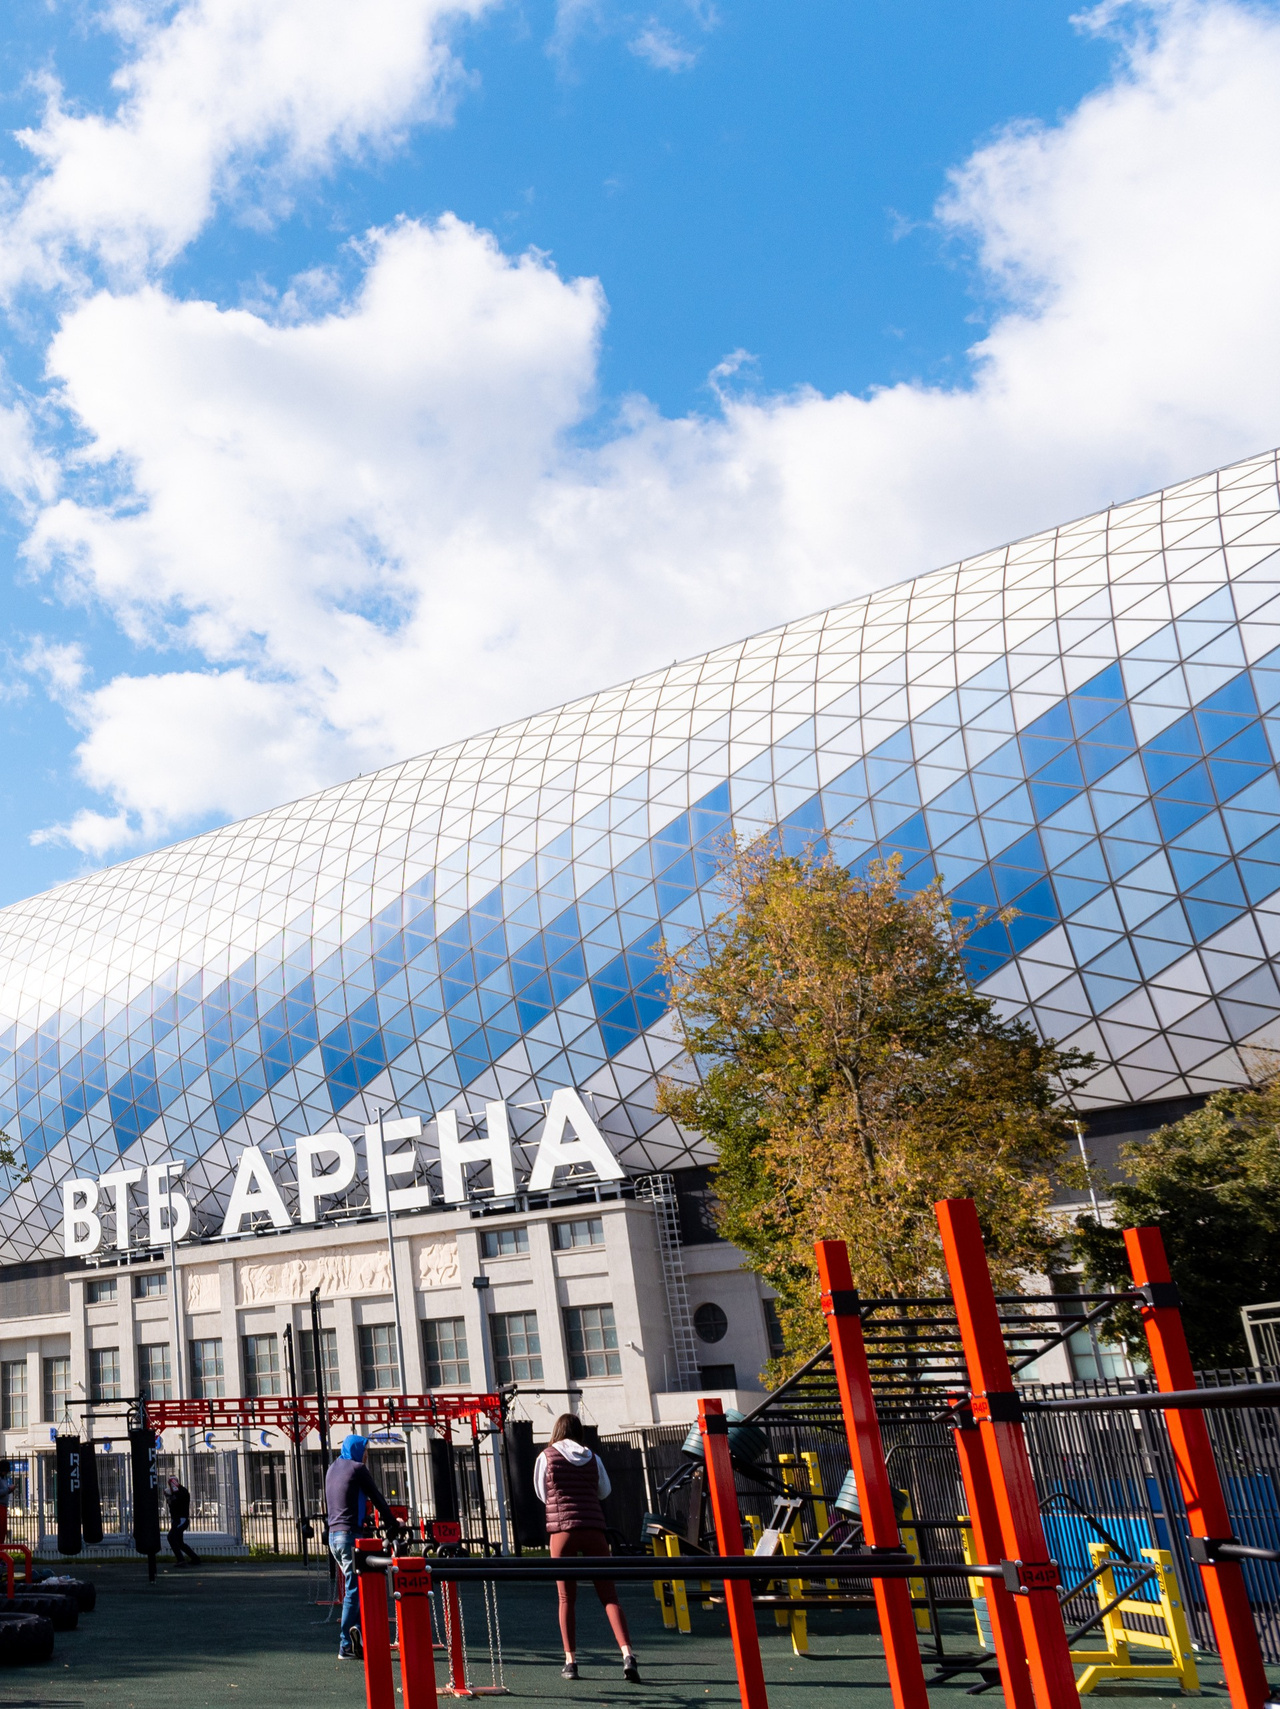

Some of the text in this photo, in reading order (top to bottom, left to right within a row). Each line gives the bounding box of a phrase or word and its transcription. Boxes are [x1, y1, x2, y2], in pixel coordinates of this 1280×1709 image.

[62, 1087, 626, 1257] ВТБ АРЕНА
[69, 1452, 80, 1493] R4P
[148, 1447, 158, 1489] R4P
[397, 1576, 429, 1588] R4P
[1022, 1570, 1056, 1582] R4P
